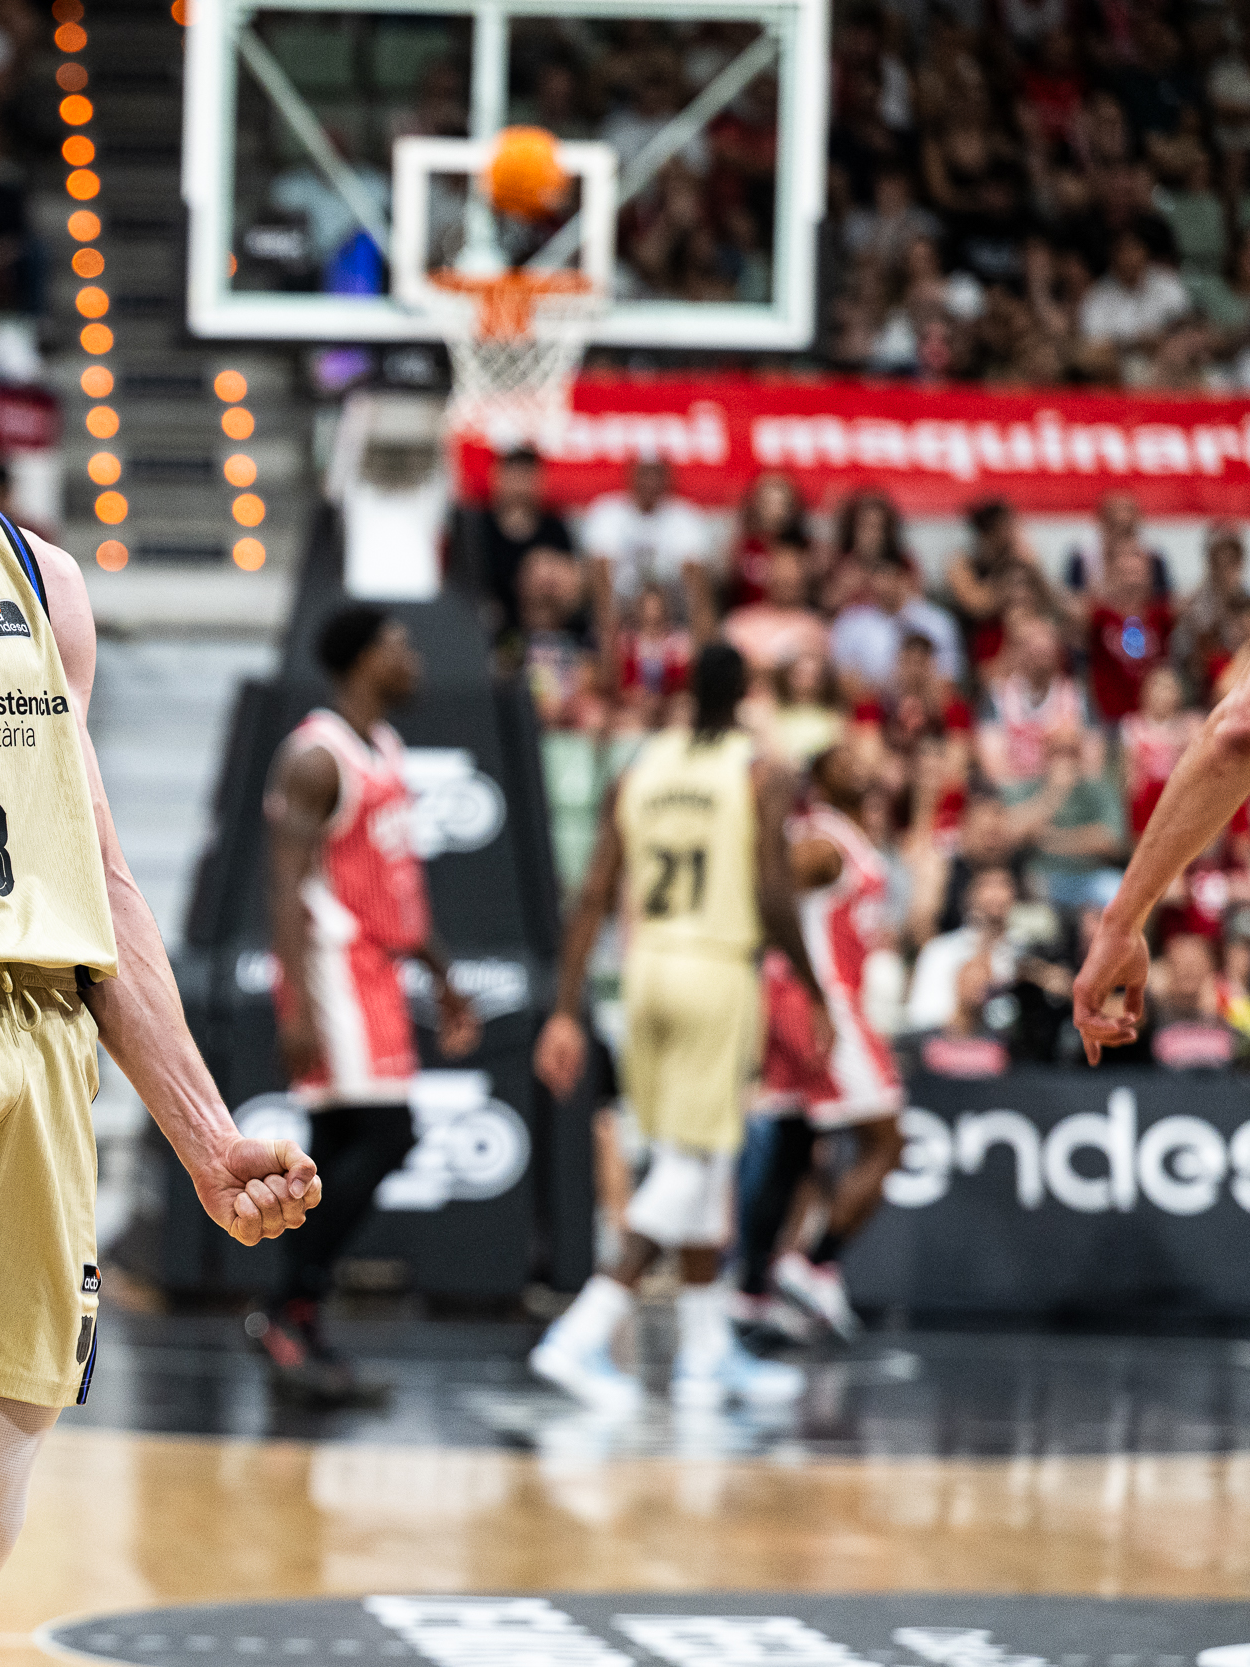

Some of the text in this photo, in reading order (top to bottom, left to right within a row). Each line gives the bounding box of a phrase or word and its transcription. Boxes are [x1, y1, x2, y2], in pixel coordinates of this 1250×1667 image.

[752, 408, 1250, 482] maquinar
[643, 843, 708, 920] 21
[84, 1275, 99, 1290] acb
